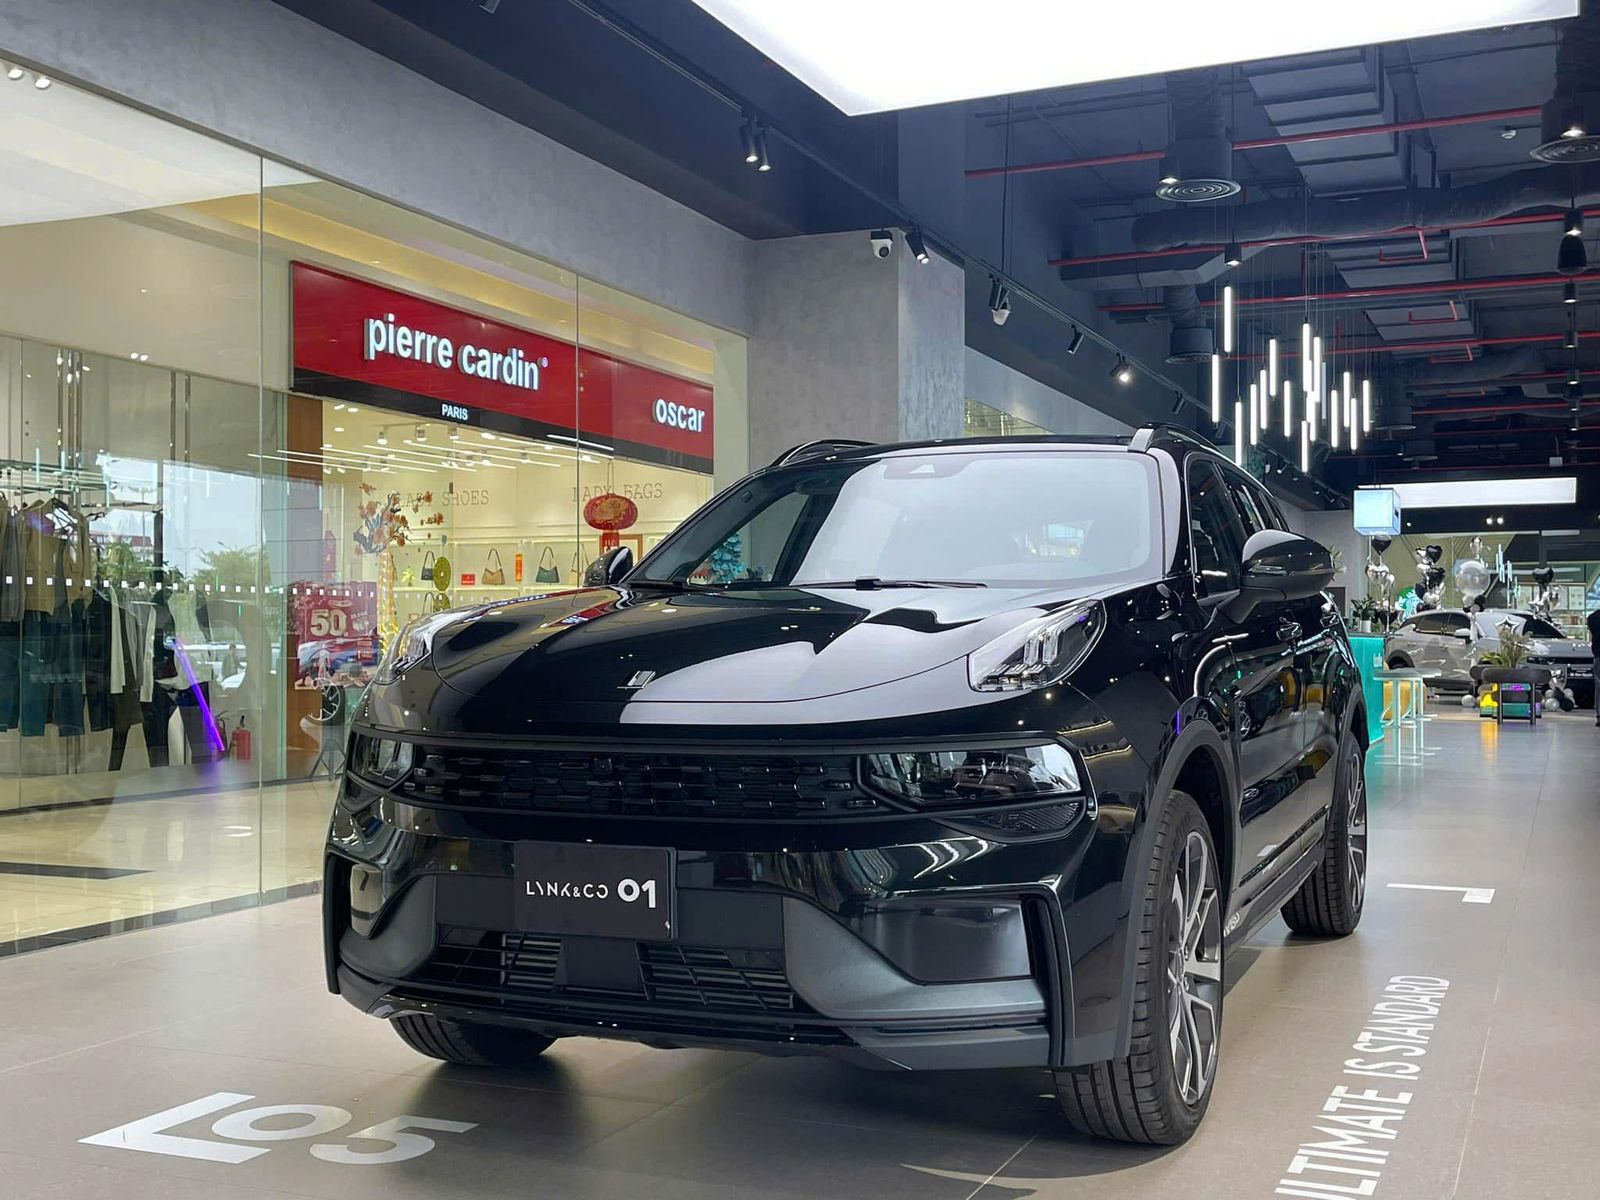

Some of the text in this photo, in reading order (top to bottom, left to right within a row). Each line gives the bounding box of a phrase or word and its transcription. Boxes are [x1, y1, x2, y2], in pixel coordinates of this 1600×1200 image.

[366, 312, 453, 369] pierre
[441, 403, 468, 421] PARIS
[654, 398, 705, 433] oscar
[442, 490, 489, 507] SHOES
[623, 482, 663, 500] BAGS
[617, 878, 656, 909] 01
[1352, 975, 1451, 1057] STANDARD
[1343, 1058, 1421, 1080] IS
